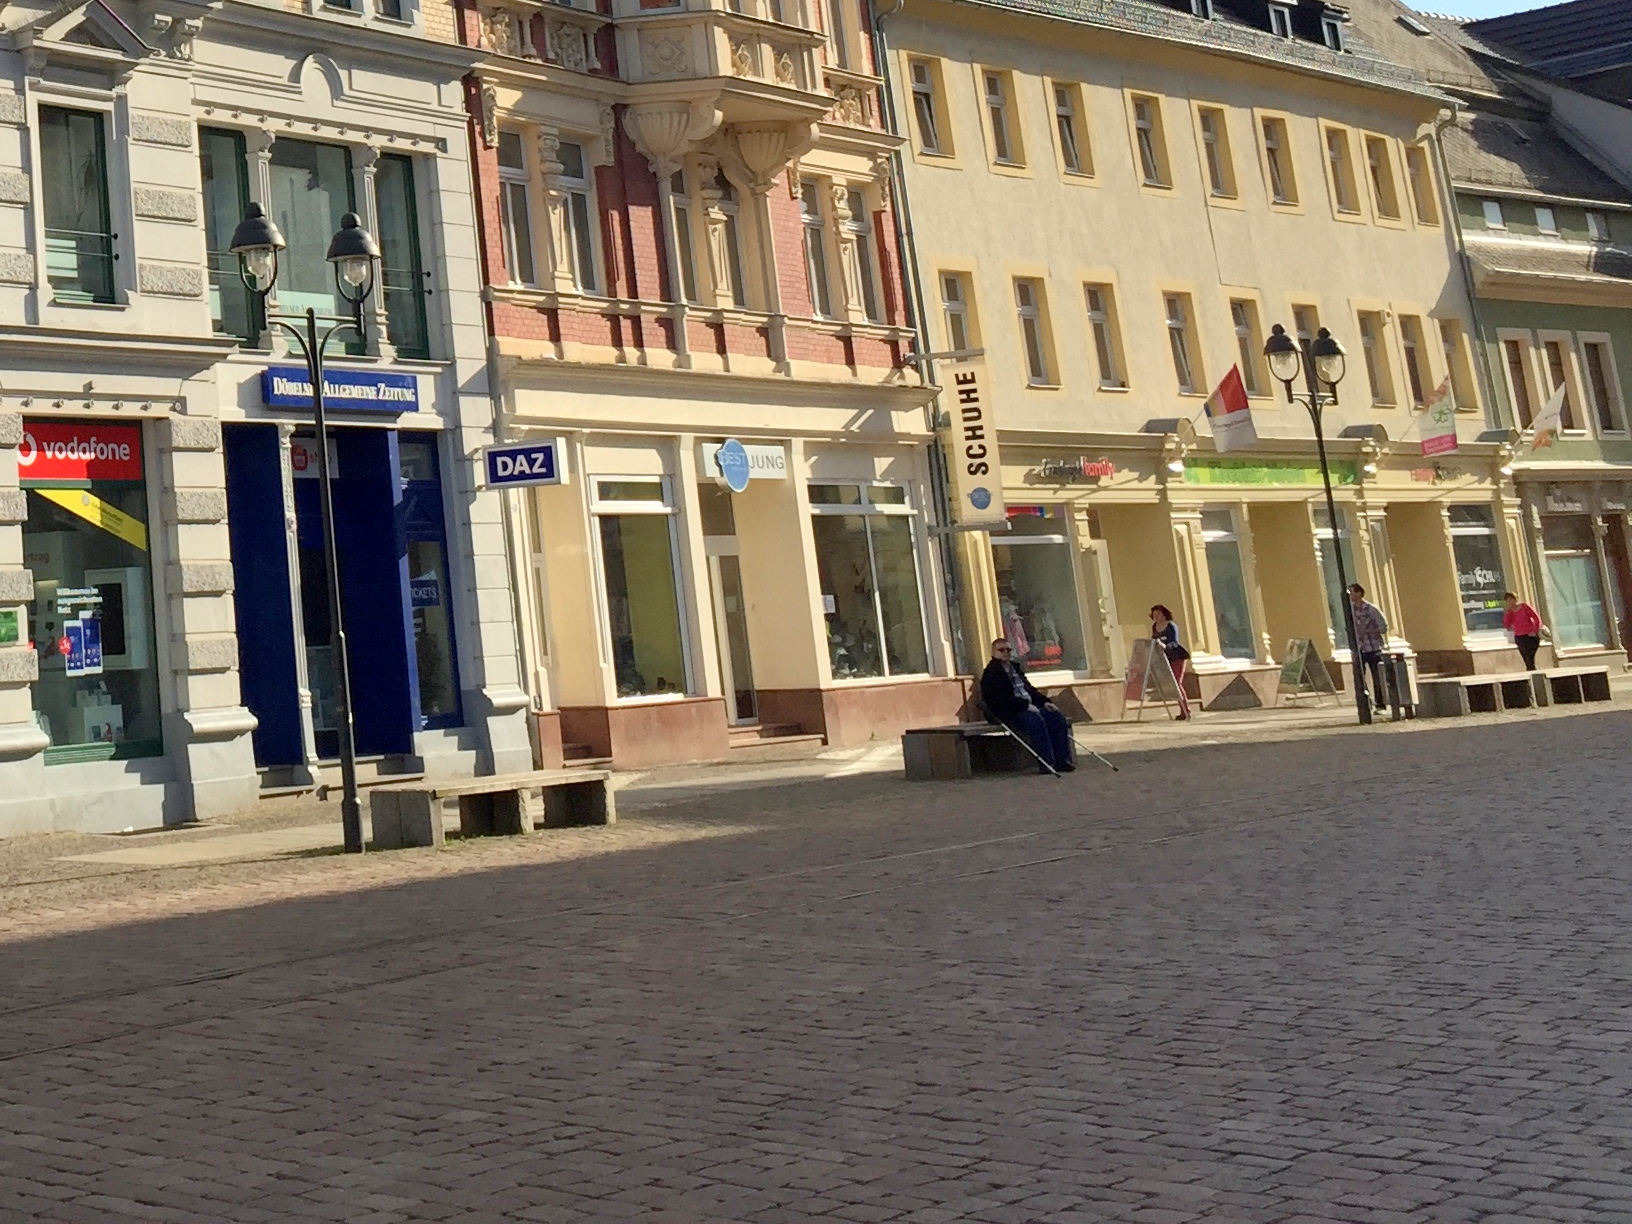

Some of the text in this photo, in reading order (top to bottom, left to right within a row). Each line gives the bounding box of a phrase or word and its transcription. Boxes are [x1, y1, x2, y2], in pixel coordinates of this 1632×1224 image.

[377, 383, 416, 402] ZEITUNG
[954, 371, 989, 476] SCHUHE
[42, 436, 131, 461] vodafone
[496, 452, 547, 477] DAZ
[749, 455, 785, 470] JUNG
